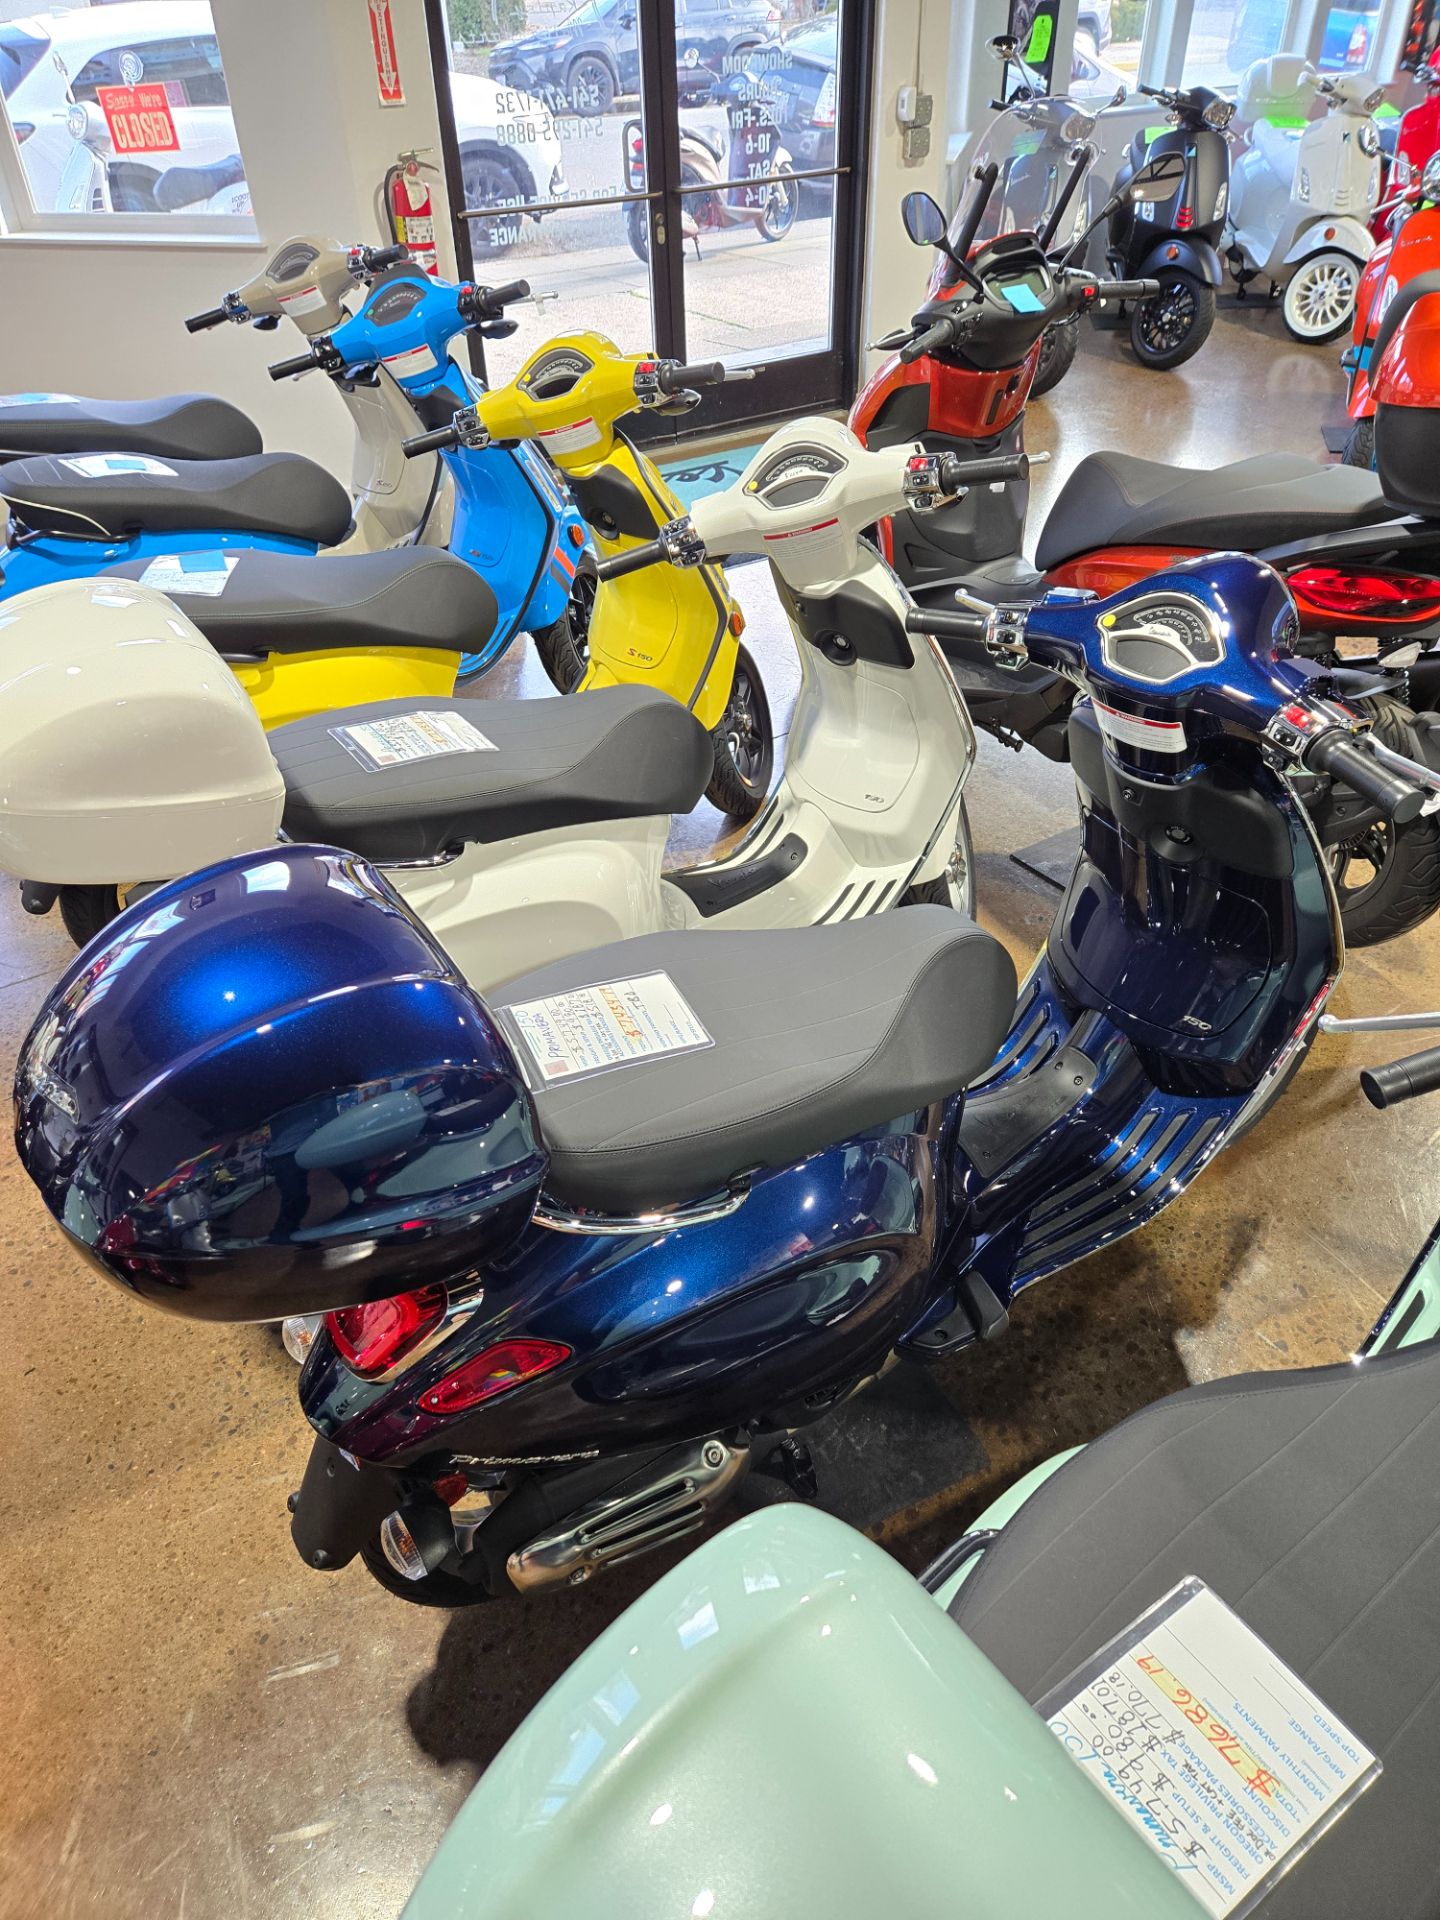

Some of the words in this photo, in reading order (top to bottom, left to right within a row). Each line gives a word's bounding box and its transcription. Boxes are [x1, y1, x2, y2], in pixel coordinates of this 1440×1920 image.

[111, 111, 174, 149] CLOSED
[1183, 1015, 1213, 1030] 150
[1232, 1702, 1280, 1752] PAYMENTS
[1312, 1713, 1342, 1744] SPEED
[1159, 1747, 1178, 1769] TAX
[1177, 1739, 1219, 1784] PACKAGE
[1287, 1717, 1346, 1779] MPG/RANGE
[1340, 1743, 1360, 1764] TOP
[1177, 1768, 1223, 1818] PRIVILEGE
[1278, 1752, 1325, 1801] MONTHLY
[1171, 1791, 1202, 1824] SETUP
[1201, 1822, 1211, 1834] &
[1217, 1783, 1278, 1849] ACCESSORIES
[1225, 1808, 1245, 1831] FEE
[1241, 1784, 1290, 1837] DISCOUNT
[1208, 1834, 1250, 1880] FREIGHT
[1222, 1818, 1264, 1864] OREGON
[1206, 1863, 1236, 1895] MSRP
